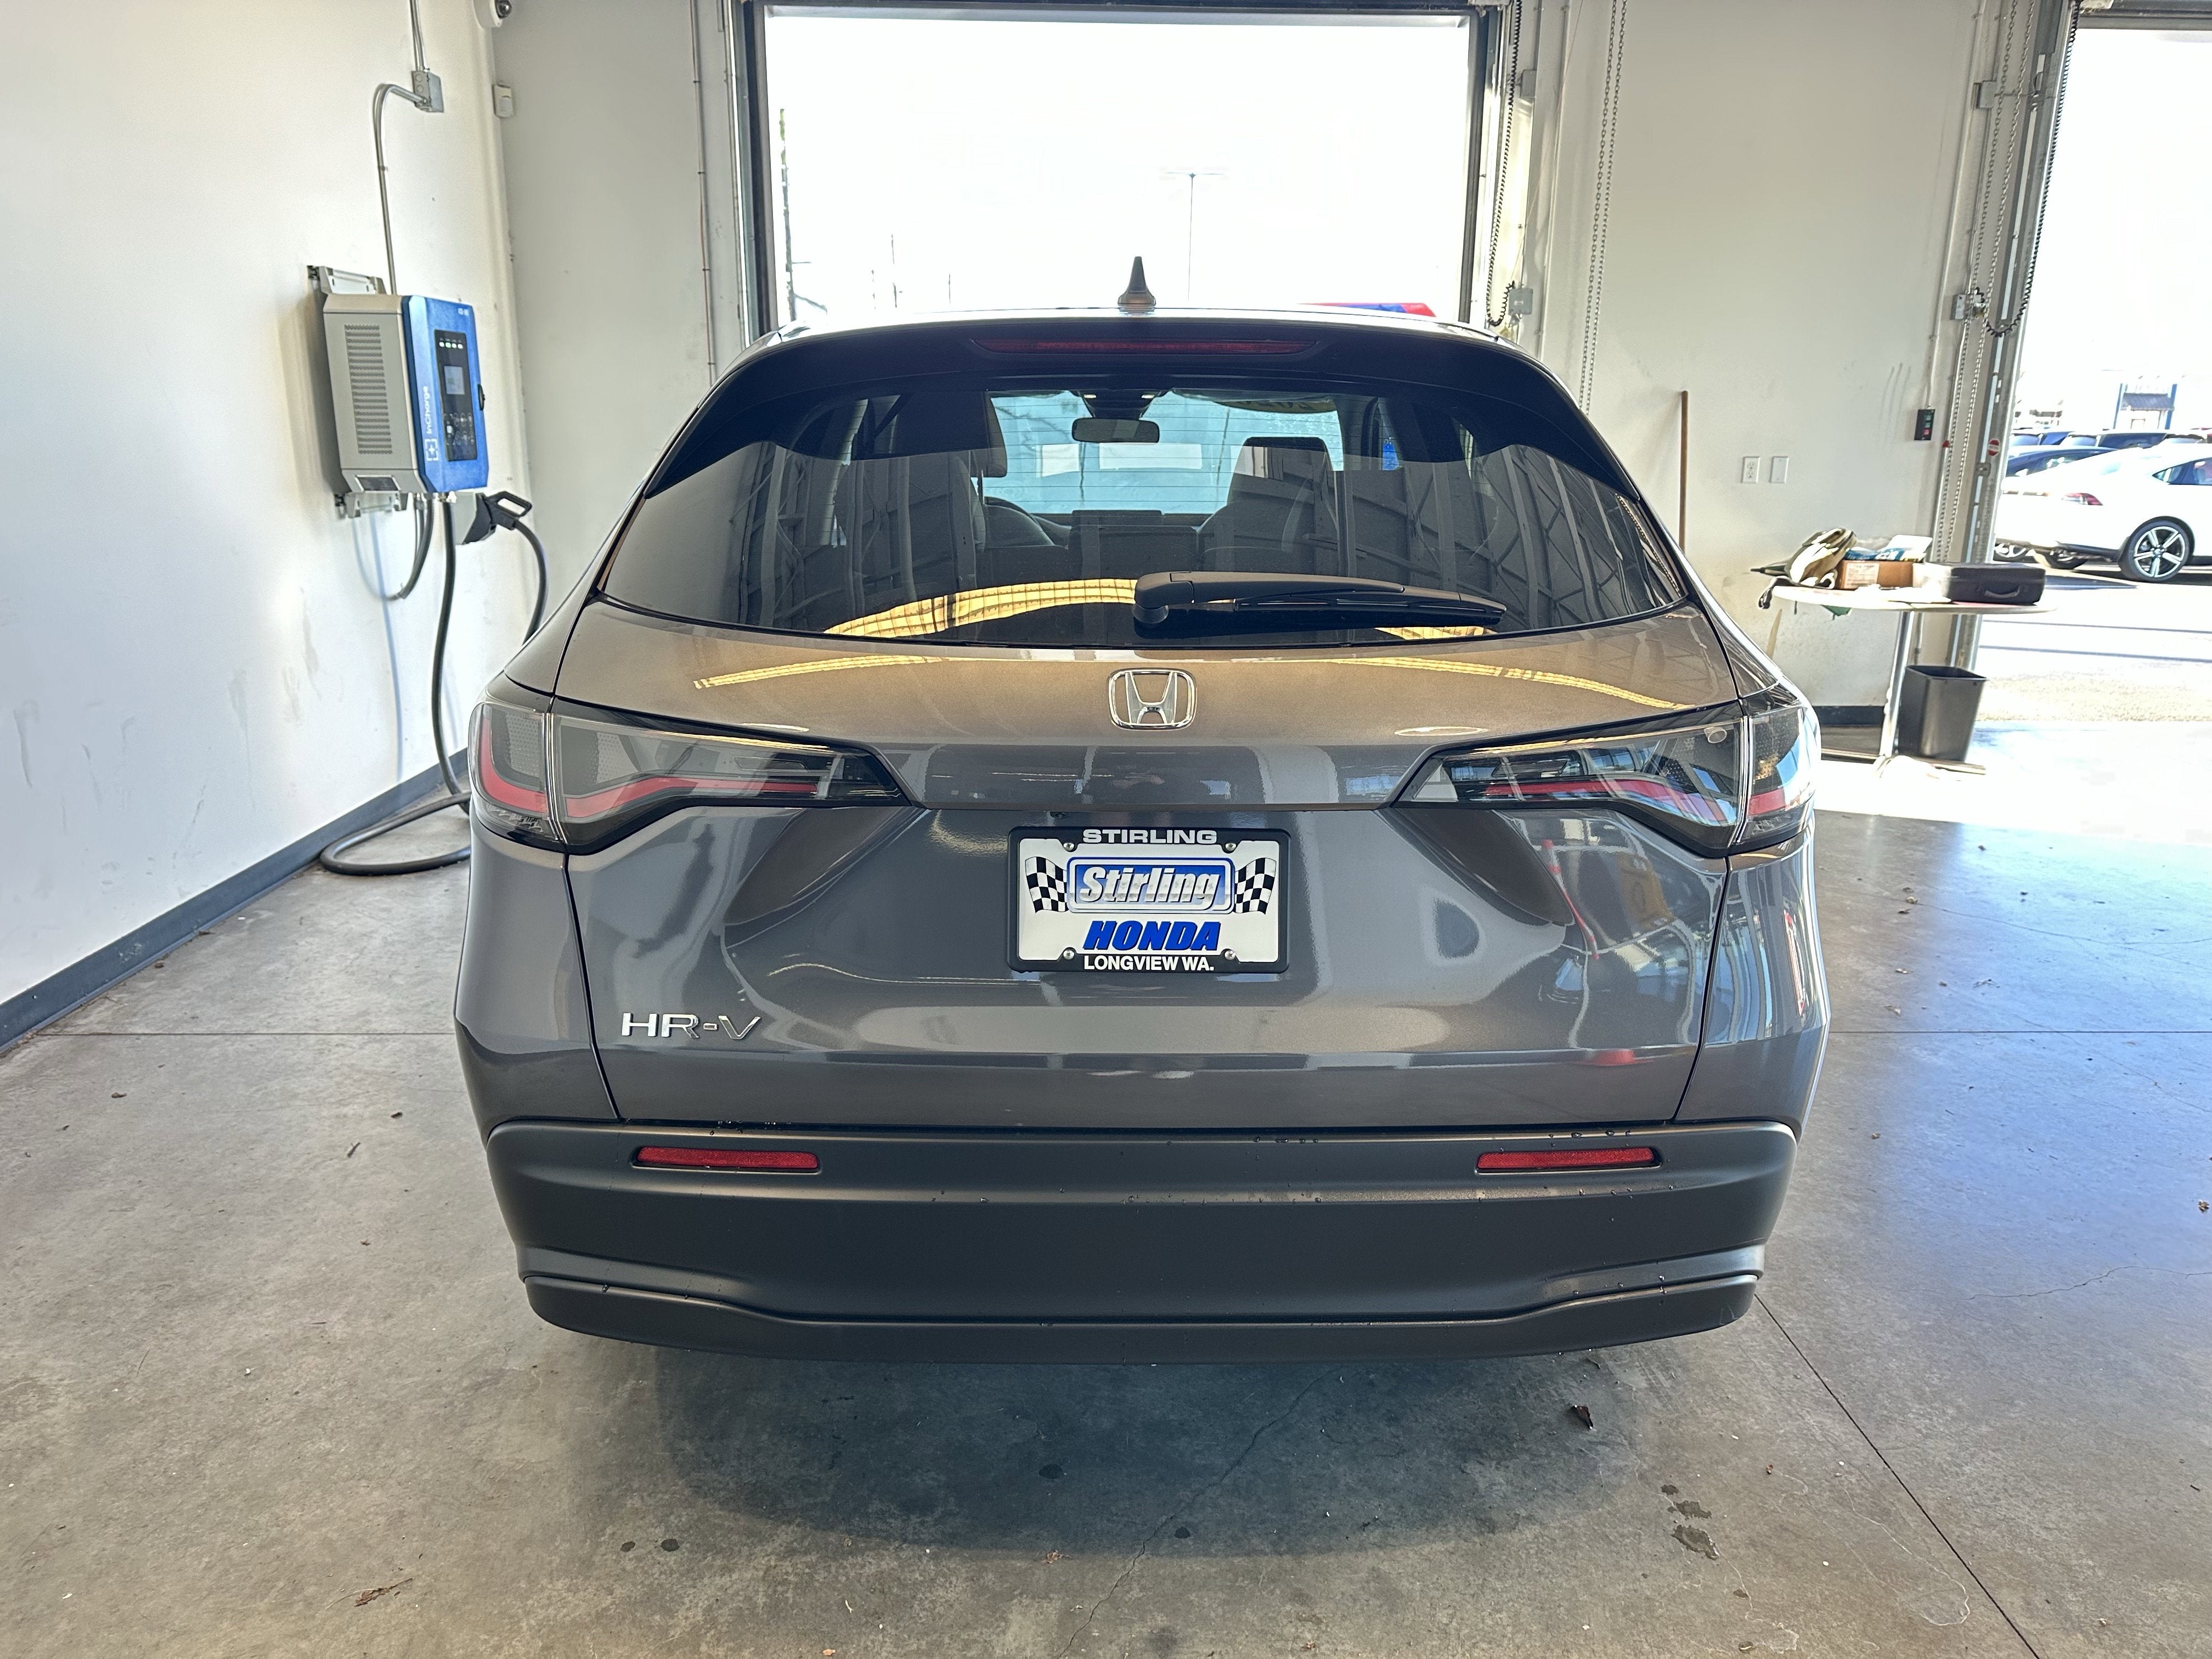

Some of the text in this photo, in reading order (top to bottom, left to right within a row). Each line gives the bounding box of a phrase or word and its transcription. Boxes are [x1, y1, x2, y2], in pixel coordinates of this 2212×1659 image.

[424, 386, 433, 435] InCharge
[1082, 829, 1217, 844] STIRLING
[1079, 866, 1220, 910] Stirling
[1083, 920, 1221, 951] HONDA
[1084, 955, 1215, 971] LONGVIEW WA.
[621, 1012, 761, 1040] HR-V
